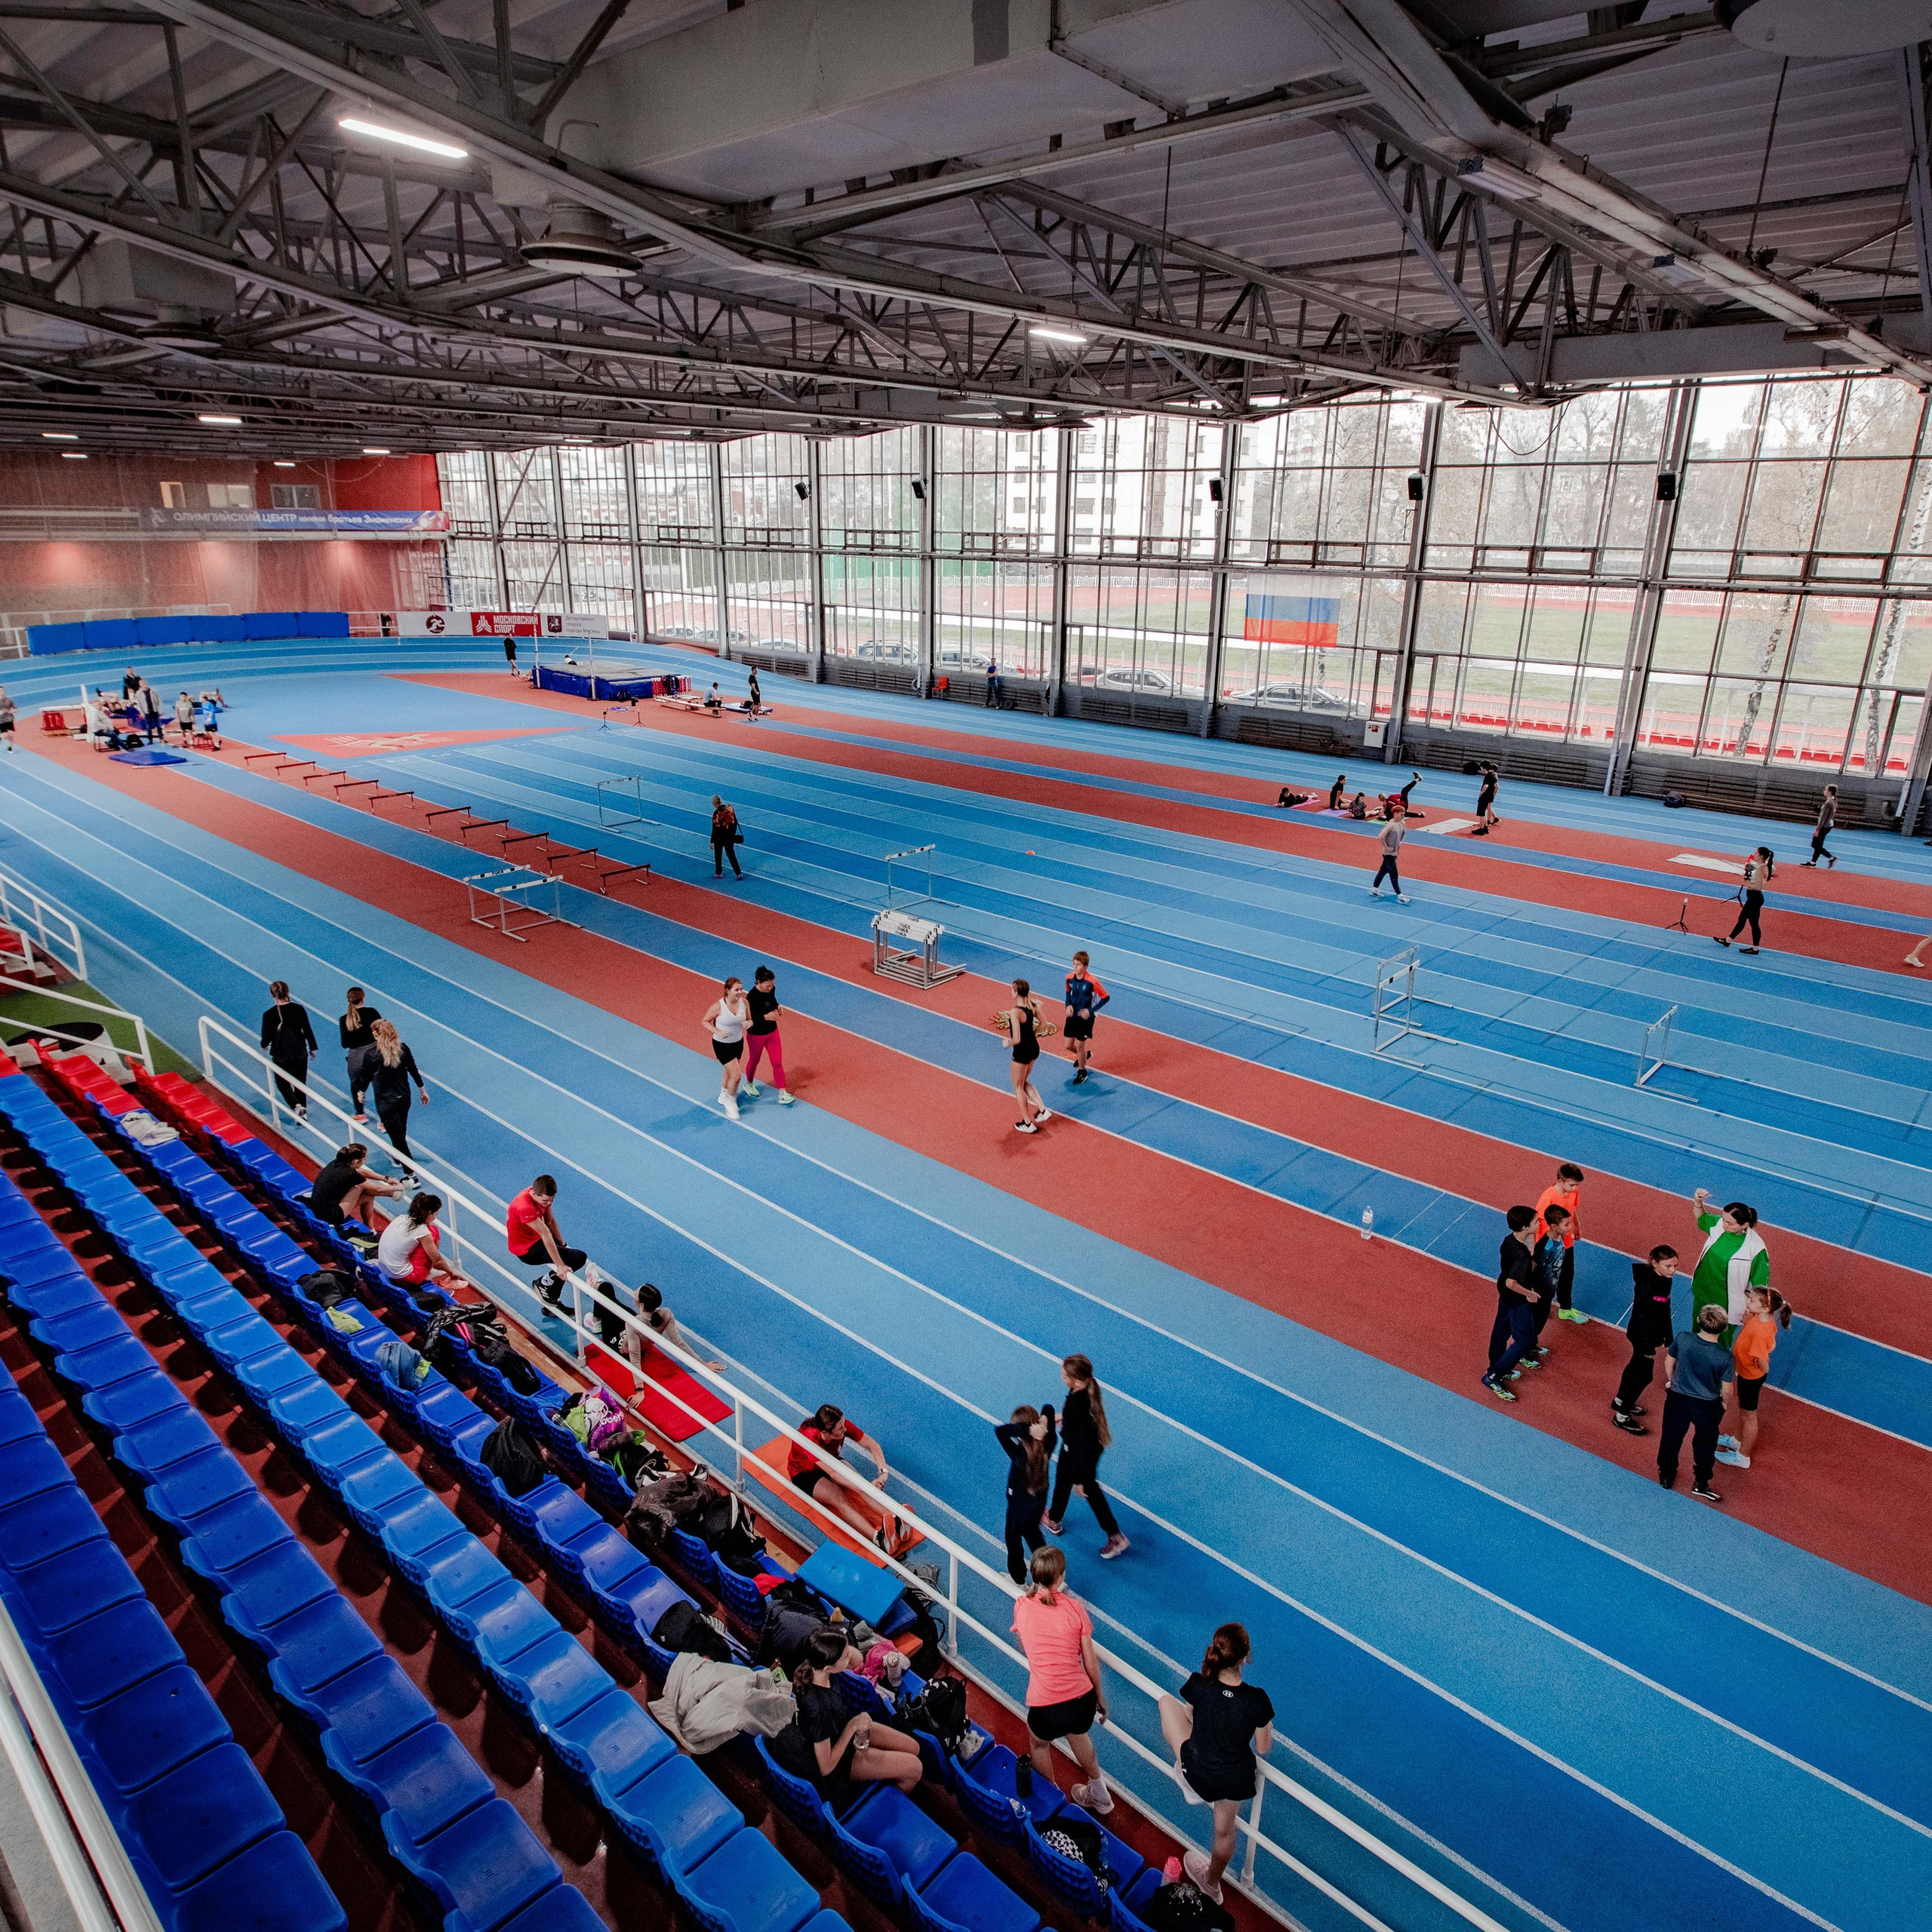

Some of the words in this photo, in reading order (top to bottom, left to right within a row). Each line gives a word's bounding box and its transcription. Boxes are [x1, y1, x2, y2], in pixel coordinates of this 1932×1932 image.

[173, 511, 260, 521] ОЛИМПИЙСКИЙ
[263, 513, 297, 523] ЦЕНТР
[328, 514, 362, 524] братьев
[364, 515, 414, 523] Знаменских
[493, 614, 538, 625] МОСКОВСКИЙ
[494, 624, 515, 633] СПОРТ
